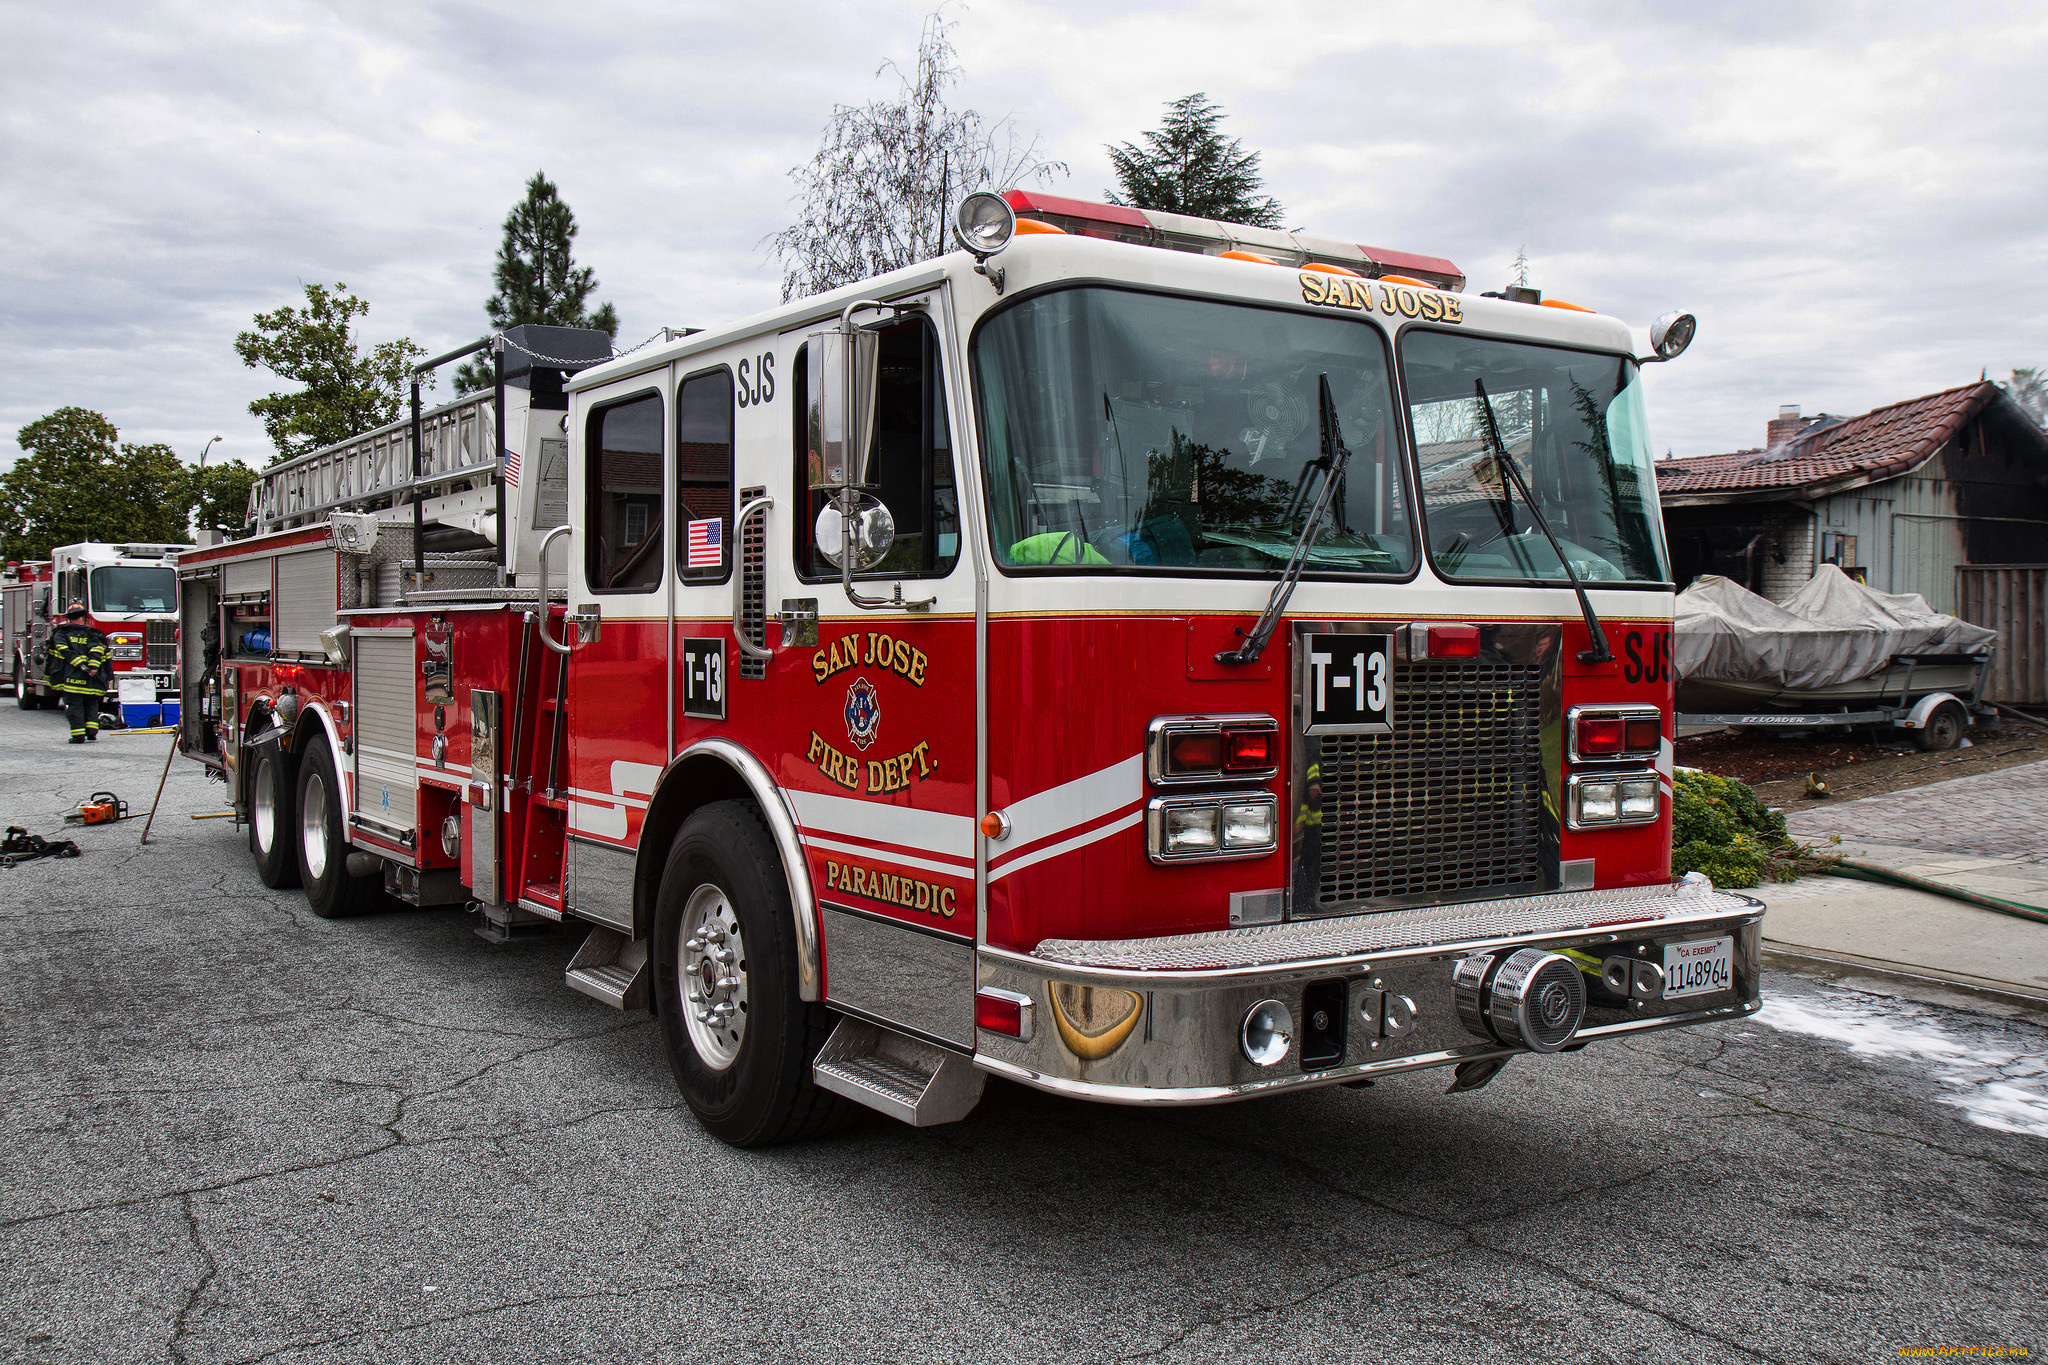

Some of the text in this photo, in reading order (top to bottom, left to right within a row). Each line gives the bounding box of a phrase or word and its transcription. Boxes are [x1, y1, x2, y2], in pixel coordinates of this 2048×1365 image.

[1298, 272, 1464, 323] SAN JOSE
[737, 351, 775, 408] SJS
[155, 676, 169, 688] E-9
[685, 651, 722, 702] T-13
[812, 632, 929, 687] SAN JOSE
[1310, 651, 1387, 712] T-13
[1624, 631, 1673, 684] SJS
[1759, 716, 1806, 724] LOADER
[807, 730, 938, 795] FIRE DEPT.
[827, 860, 957, 917] PARAMEDIC
[1668, 957, 1728, 991] 1148964
[1680, 945, 1717, 957] CA EXEMPT
